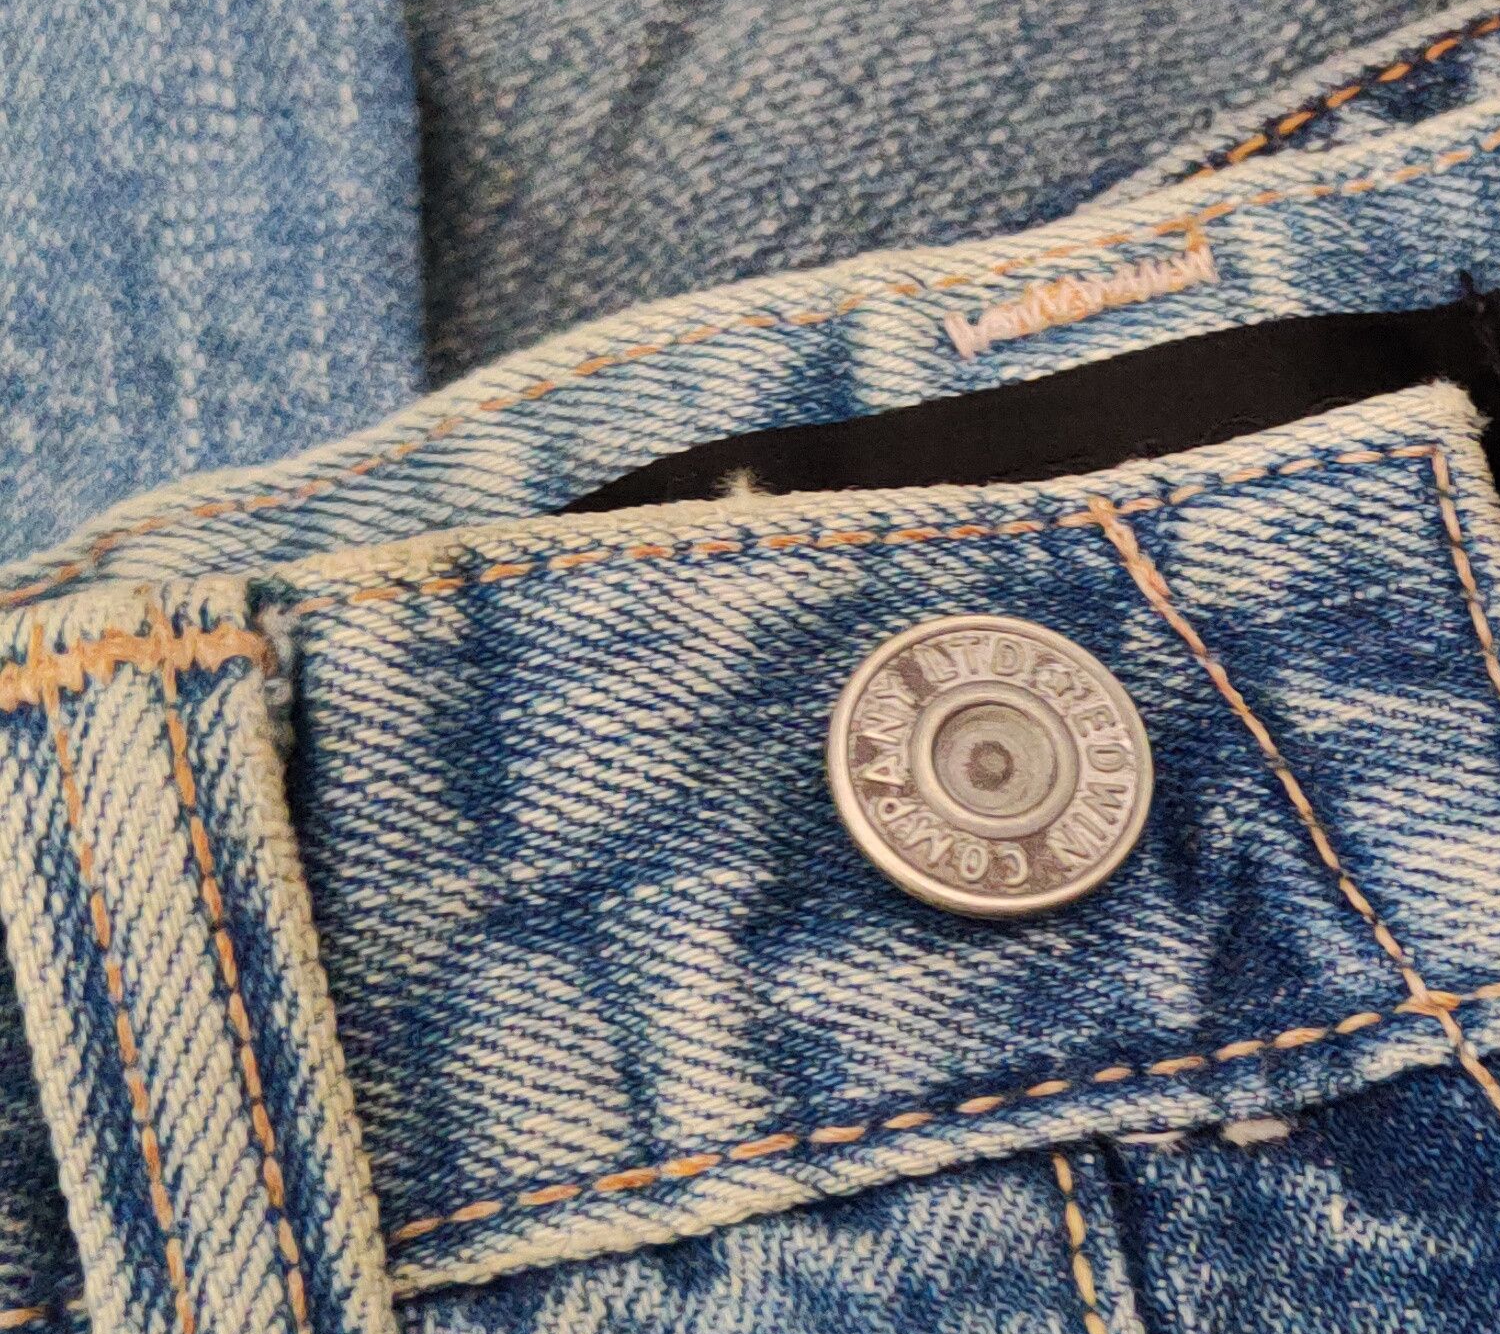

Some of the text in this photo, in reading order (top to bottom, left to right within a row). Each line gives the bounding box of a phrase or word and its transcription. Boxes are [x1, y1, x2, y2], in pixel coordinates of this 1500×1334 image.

[856, 634, 1130, 884] EDWIN COMPANY LTD
